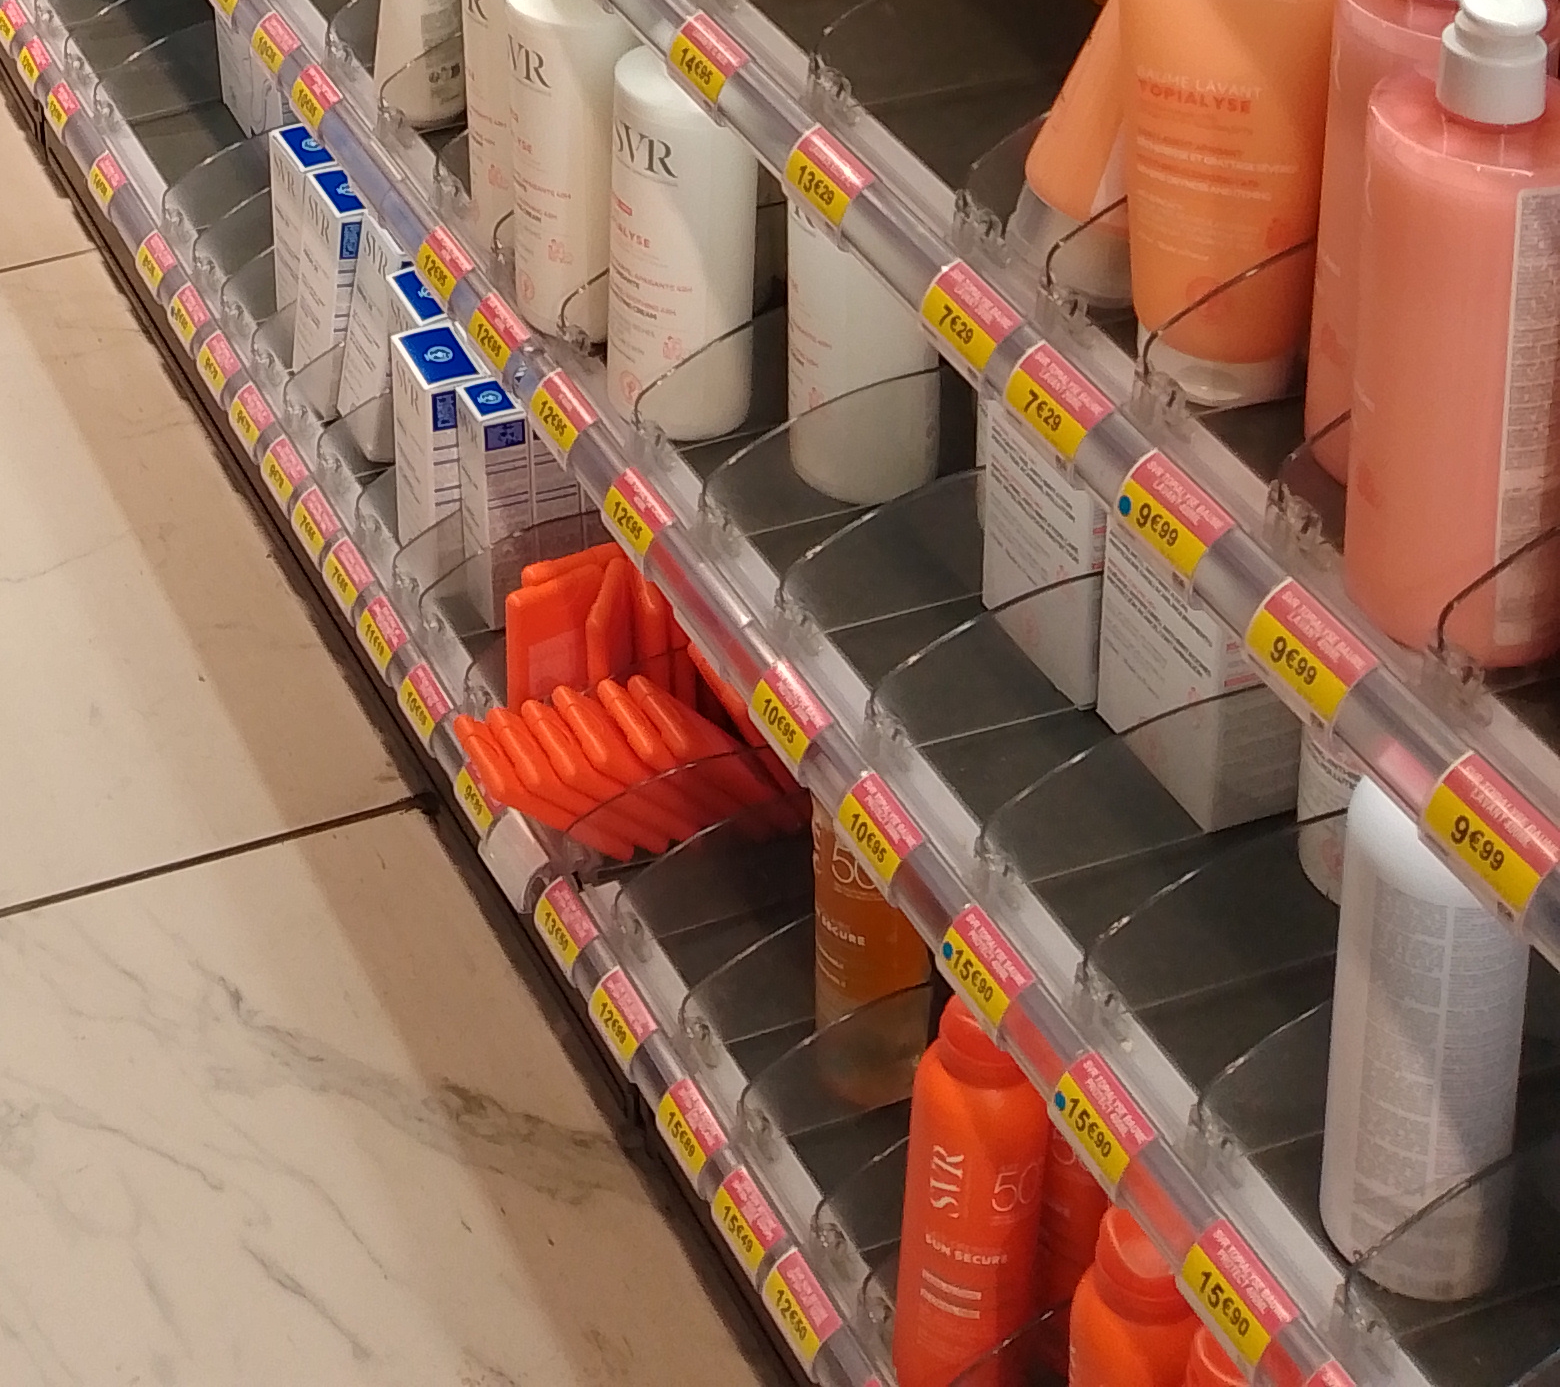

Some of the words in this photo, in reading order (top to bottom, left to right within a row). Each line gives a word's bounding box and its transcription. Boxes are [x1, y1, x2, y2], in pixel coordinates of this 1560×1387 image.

[679, 46, 713, 85] 14€95
[1195, 75, 1263, 99] LAVANT
[1138, 78, 1251, 114] TOPIALYSE
[613, 122, 678, 178] SVR
[797, 165, 835, 206] 13€29
[938, 304, 974, 346] 7€29
[1023, 389, 1062, 431] 7€29
[611, 501, 644, 541] 12€95
[1136, 502, 1179, 547] 9€99
[1269, 635, 1318, 686] 9€99
[763, 697, 798, 745] 10€95
[849, 812, 888, 864] 10€95
[1450, 814, 1505, 872] 9€99
[831, 847, 876, 889] 50
[952, 948, 995, 1004] 15€90
[1066, 1096, 1113, 1159] 15€90
[929, 1145, 965, 1219] SVR
[991, 1168, 1044, 1214] 50
[924, 1233, 952, 1257] SUN
[954, 1249, 1009, 1266] SECURE
[774, 1288, 808, 1342] 12€50
[1198, 1268, 1250, 1338] 15€90
